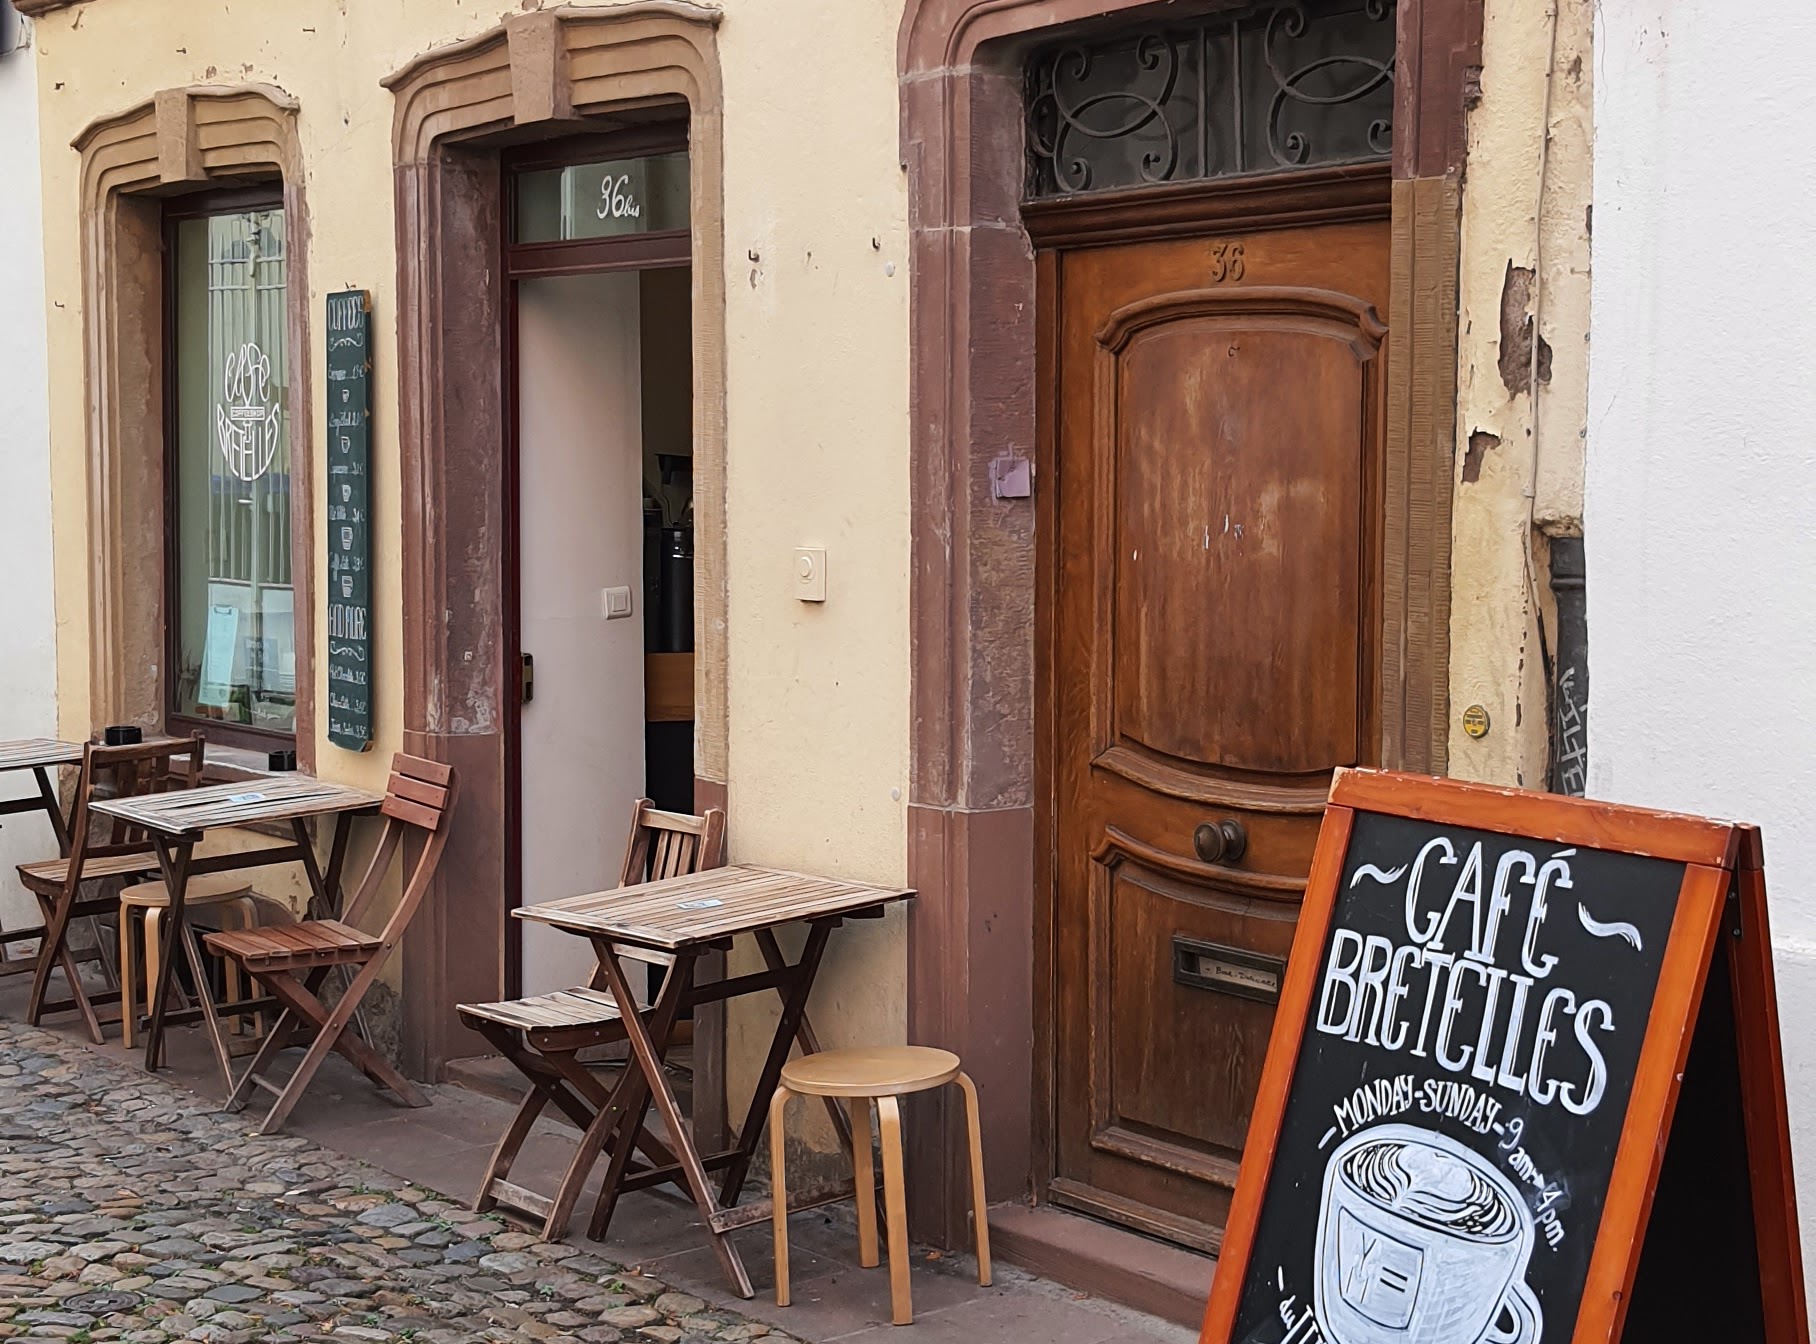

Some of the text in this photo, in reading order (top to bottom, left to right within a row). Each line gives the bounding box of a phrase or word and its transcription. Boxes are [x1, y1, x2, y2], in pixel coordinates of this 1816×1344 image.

[1211, 242, 1245, 283] 36
[217, 402, 280, 481] BRETELLES
[1405, 836, 1577, 978] CAFÉ
[1316, 928, 1616, 1116] BRETELLES
[1279, 1295, 1296, 1330] du
